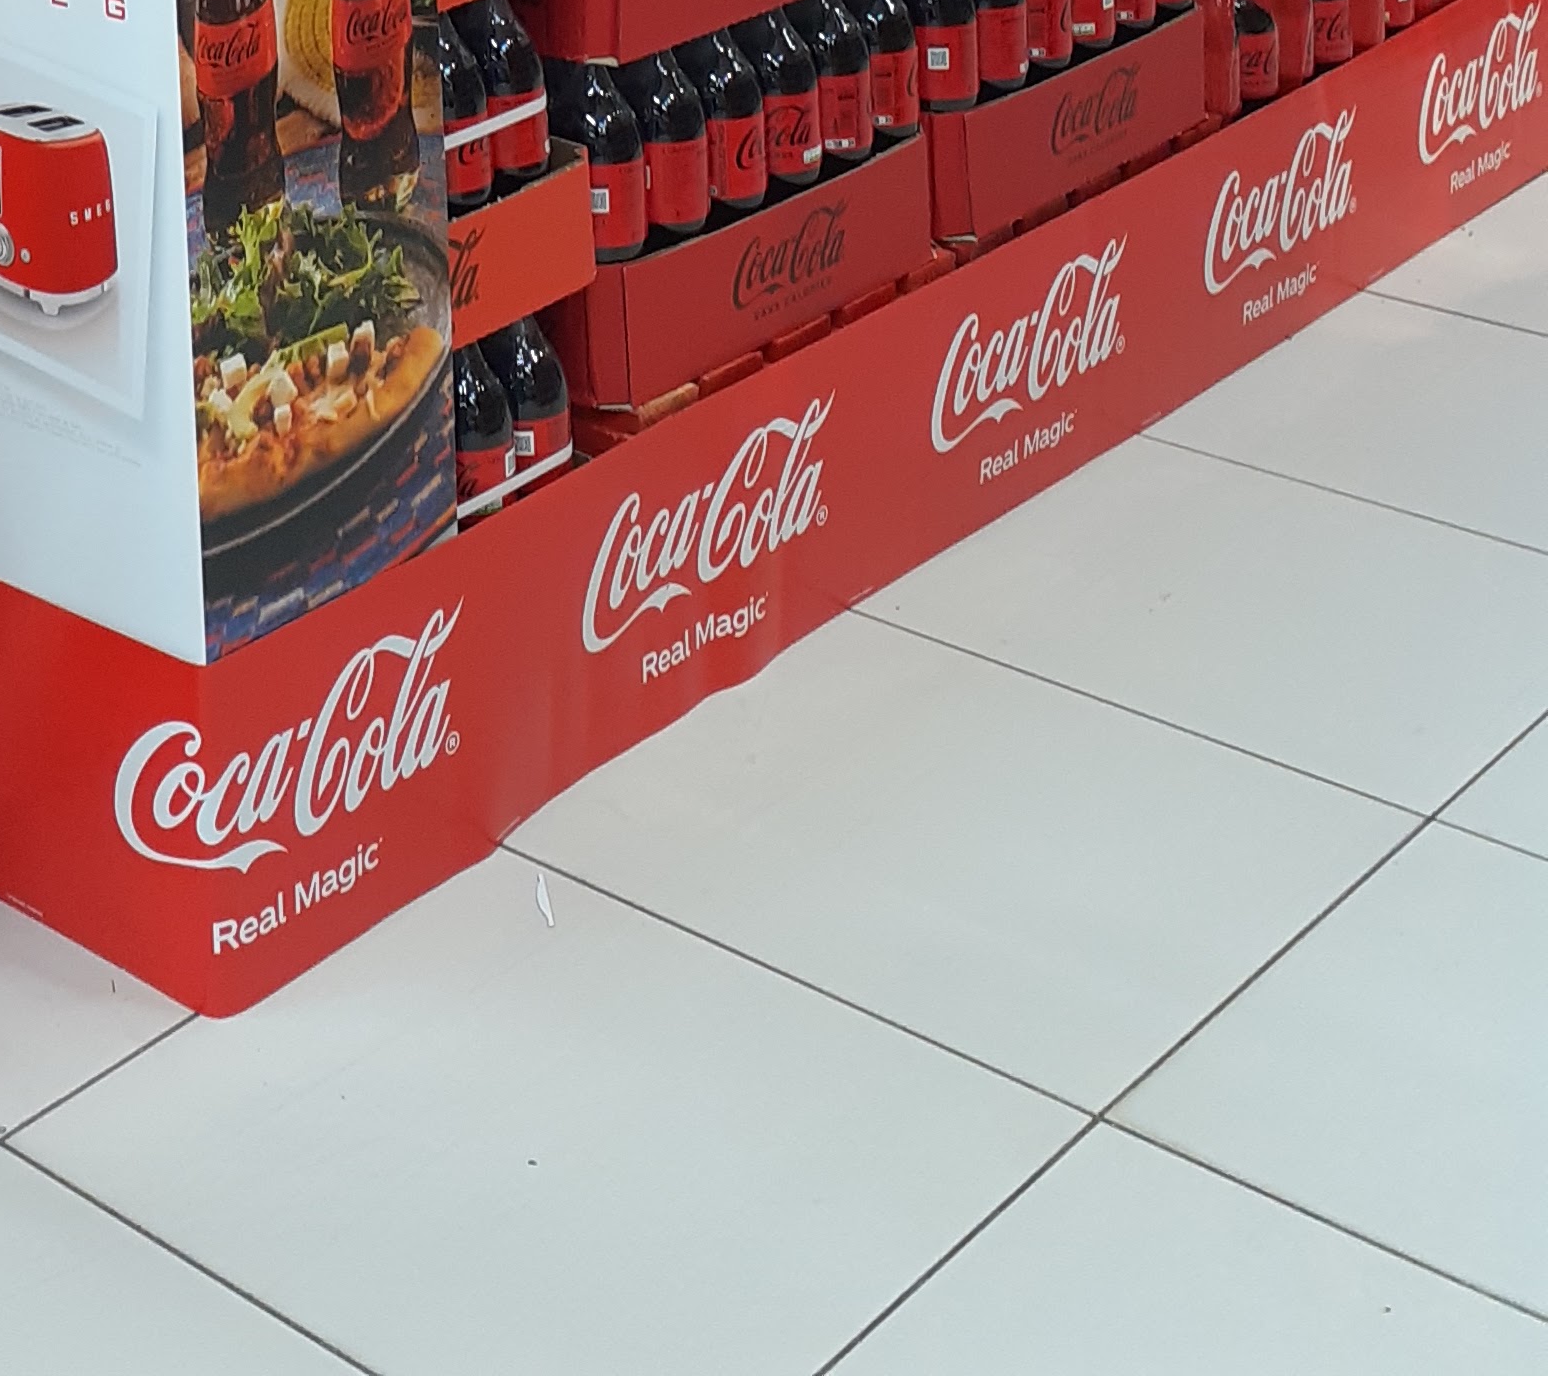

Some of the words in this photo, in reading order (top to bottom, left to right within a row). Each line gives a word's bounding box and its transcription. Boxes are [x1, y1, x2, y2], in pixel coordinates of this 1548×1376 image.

[1418, 0, 1544, 167] Coca-Cola
[1204, 105, 1357, 296] Coca-Cola
[1449, 163, 1477, 195] Real
[1478, 140, 1512, 175] Magic
[731, 197, 852, 313] Coca-Cola
[1242, 288, 1275, 326] Real
[1277, 261, 1319, 306] Magic
[931, 232, 1129, 454] Coca-Cola
[979, 445, 1019, 484] Real
[1023, 410, 1076, 460] Magic
[582, 388, 836, 654] Coca-Cola
[641, 626, 691, 684] Real
[694, 592, 768, 656] Magic
[114, 594, 466, 875] Coca-Cola
[212, 893, 288, 955] Real
[294, 840, 381, 916] Magic
